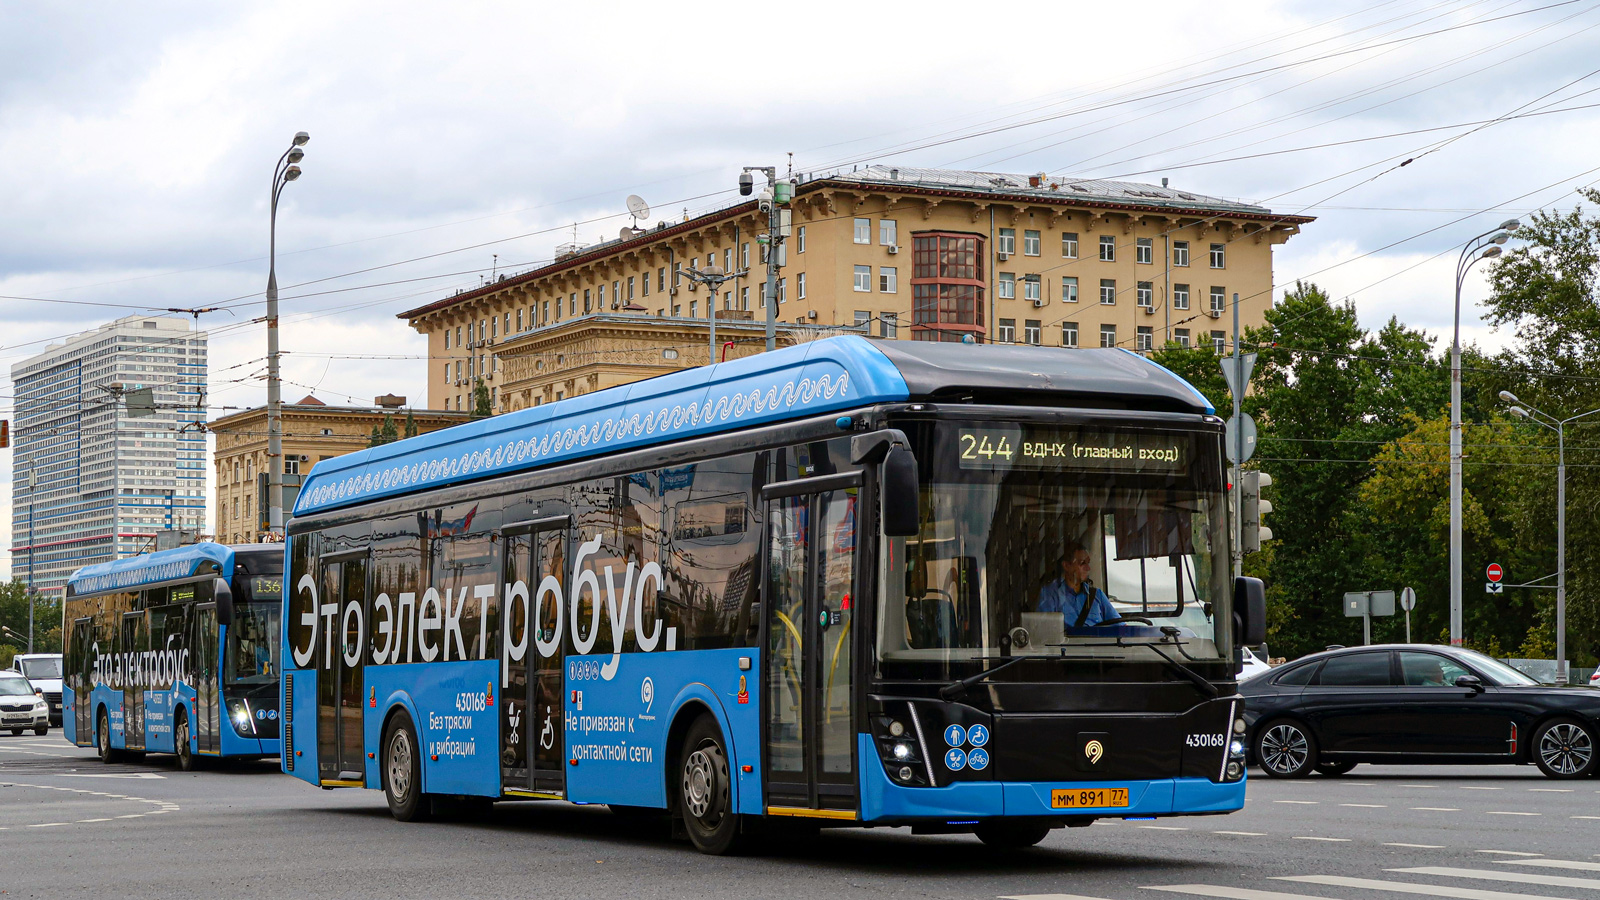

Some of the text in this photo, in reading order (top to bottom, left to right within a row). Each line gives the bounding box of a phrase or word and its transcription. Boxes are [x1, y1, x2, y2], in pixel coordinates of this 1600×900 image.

[960, 434, 1179, 462] 244 ВДНХ (главный вход)
[256, 580, 281, 593] 136
[293, 573, 364, 669] Это
[91, 641, 112, 688] Это
[455, 692, 486, 712] 430168
[429, 711, 472, 734] Без тряски
[564, 710, 635, 736] Не привязан к
[429, 735, 476, 760] и вибраций
[571, 740, 653, 763] контактной сети
[1185, 733, 1225, 747] 430168
[1079, 791, 1104, 805] 891
[1111, 790, 1124, 801] 77
